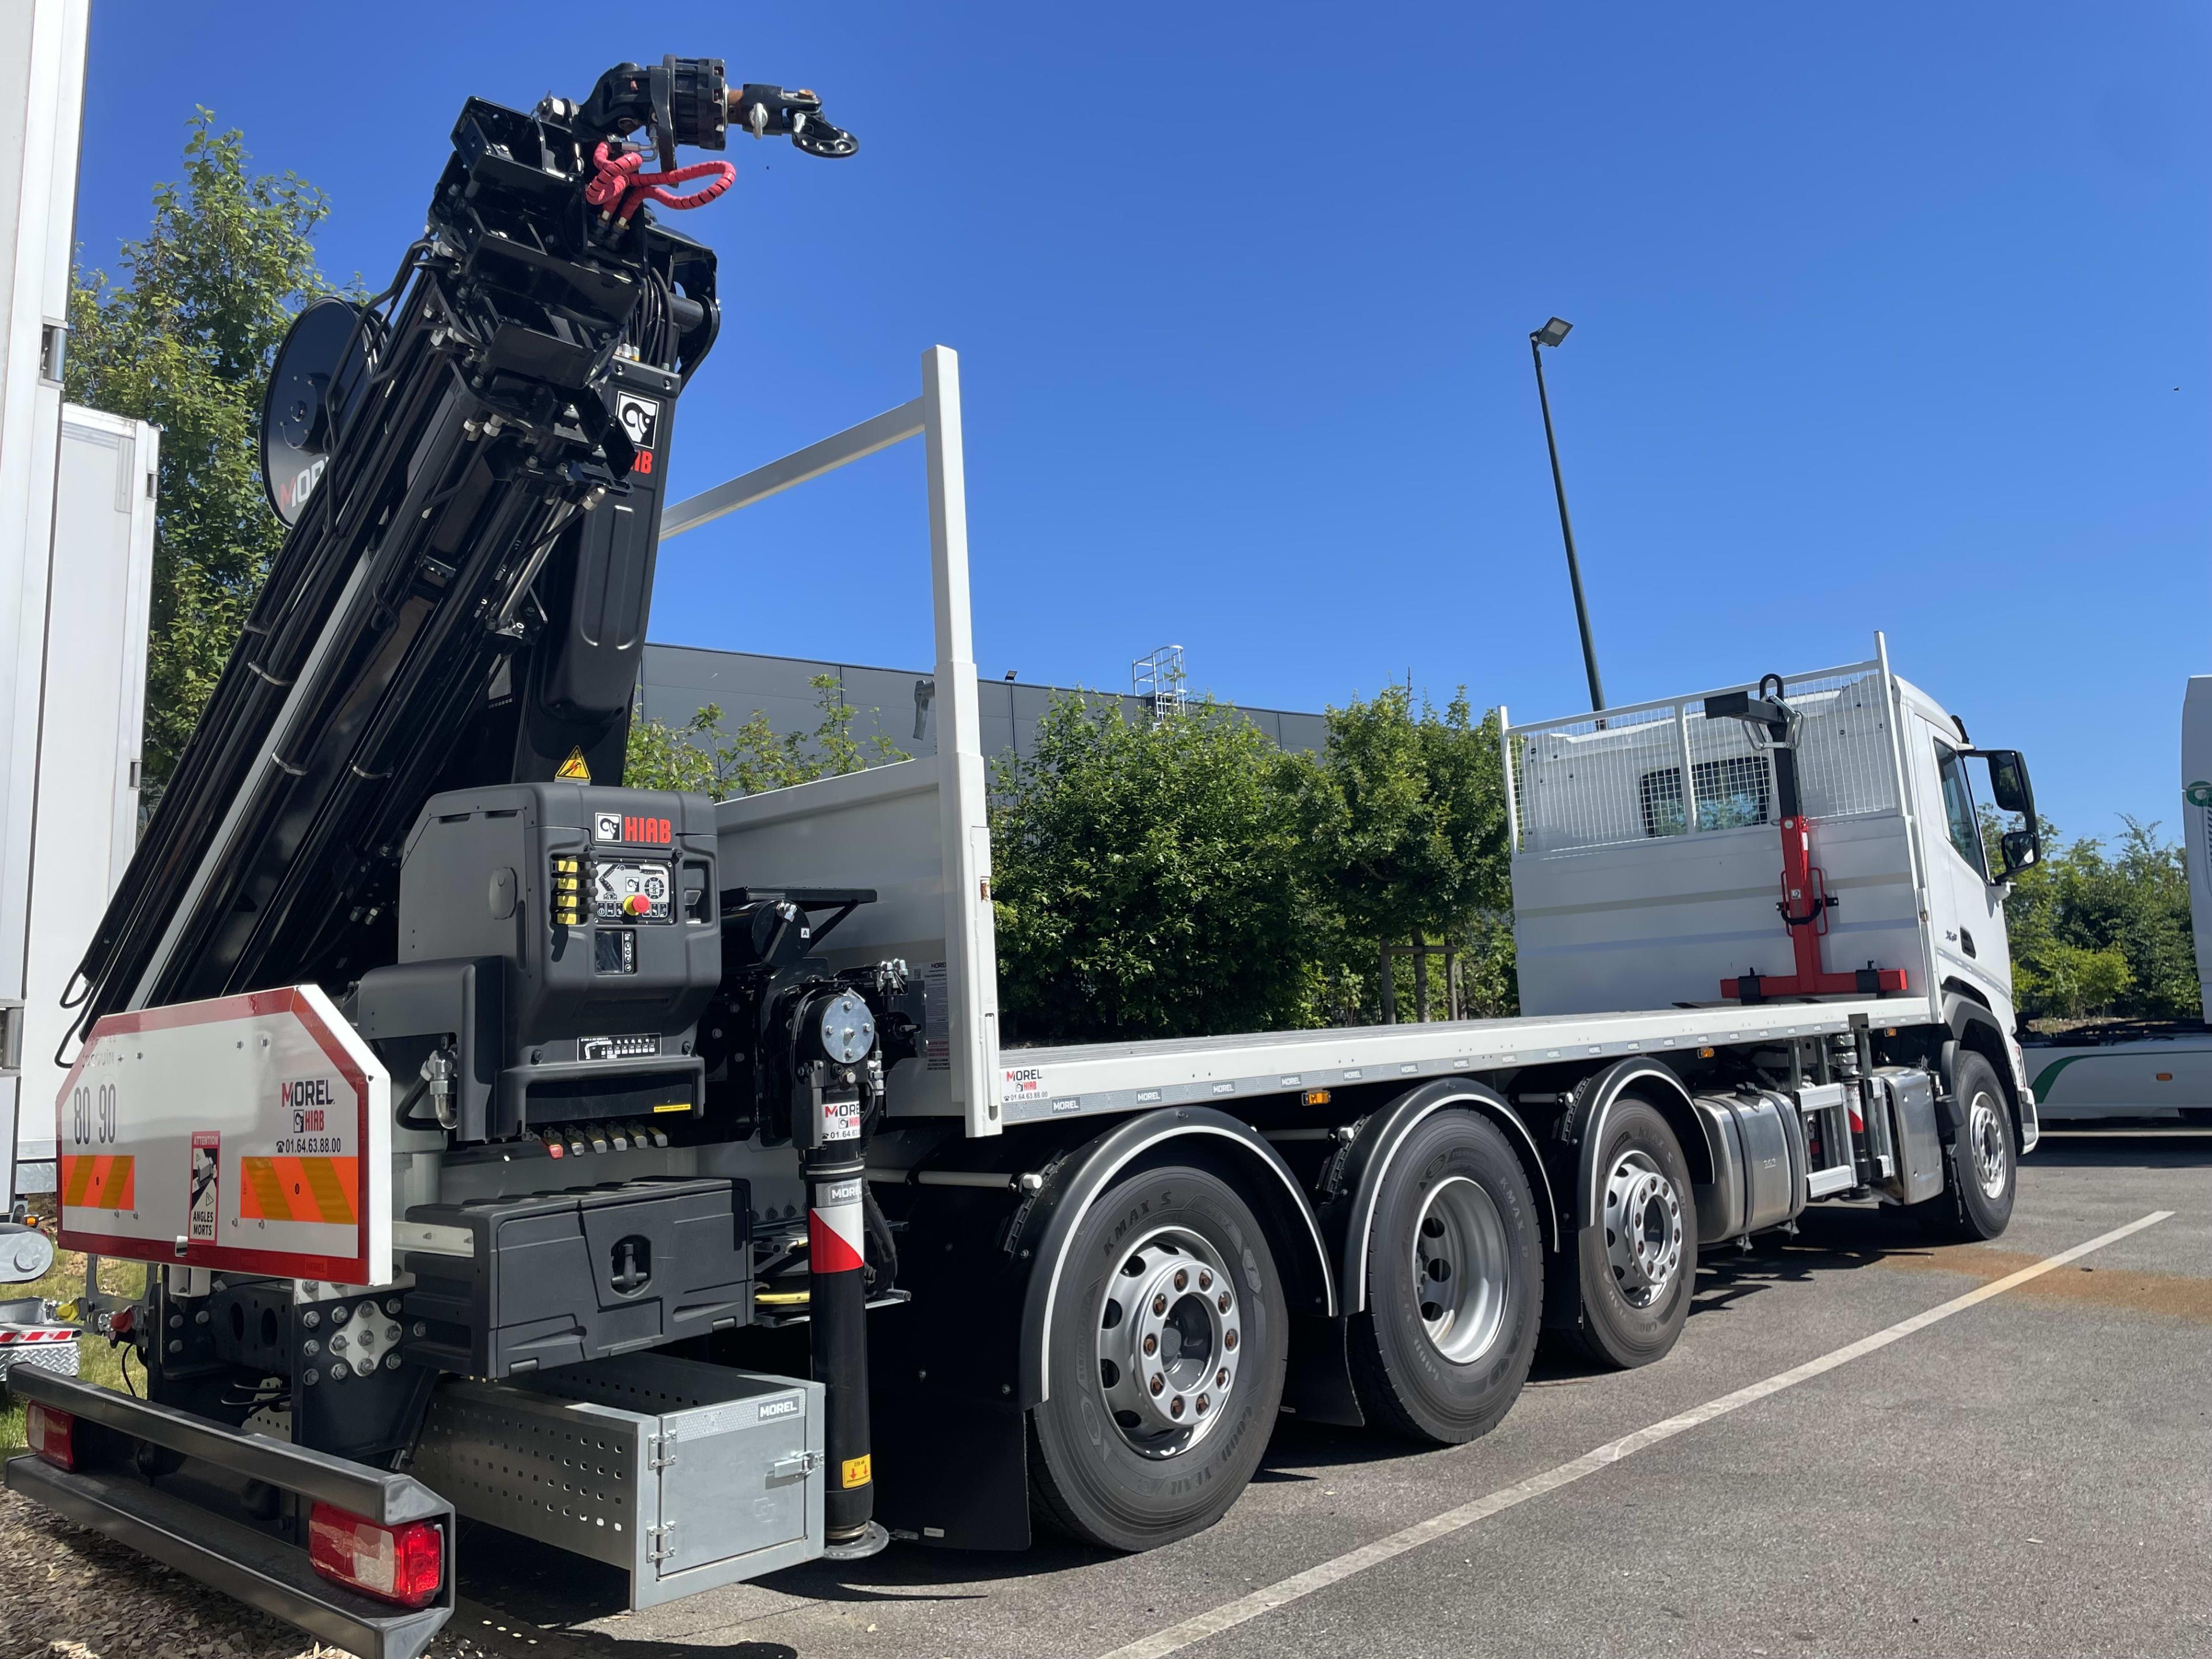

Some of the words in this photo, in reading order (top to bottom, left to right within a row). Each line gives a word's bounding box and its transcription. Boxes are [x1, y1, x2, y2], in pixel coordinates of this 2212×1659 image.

[281, 456, 329, 514] MOR
[624, 816, 671, 843] HIAB
[1006, 1069, 1043, 1082] MOREL
[1281, 1077, 1301, 1086] MOREL
[1344, 1071, 1362, 1079] MOREL
[1023, 1081, 1037, 1091] HIAB
[1213, 1084, 1234, 1093] MOREL
[282, 1080, 335, 1107] MOREL
[1010, 1091, 1048, 1101] 01.64.63.88.00
[1137, 1092, 1161, 1101] MOREL
[825, 1103, 859, 1118] MORE
[1053, 1100, 1079, 1111] MOREL
[74, 1086, 90, 1145] 80
[99, 1084, 115, 1144] 90
[305, 1110, 324, 1132] HIAB
[194, 1136, 219, 1145] ATTENTION
[286, 1137, 341, 1153] 01.64.63.88.00
[1499, 1176, 1525, 1231] KMAX
[193, 1211, 213, 1222] ANGLES
[1101, 1198, 1150, 1257] KMAX
[1161, 1189, 1172, 1206] S
[194, 1224, 212, 1236] MORTS
[760, 1401, 797, 1418] MOREL
